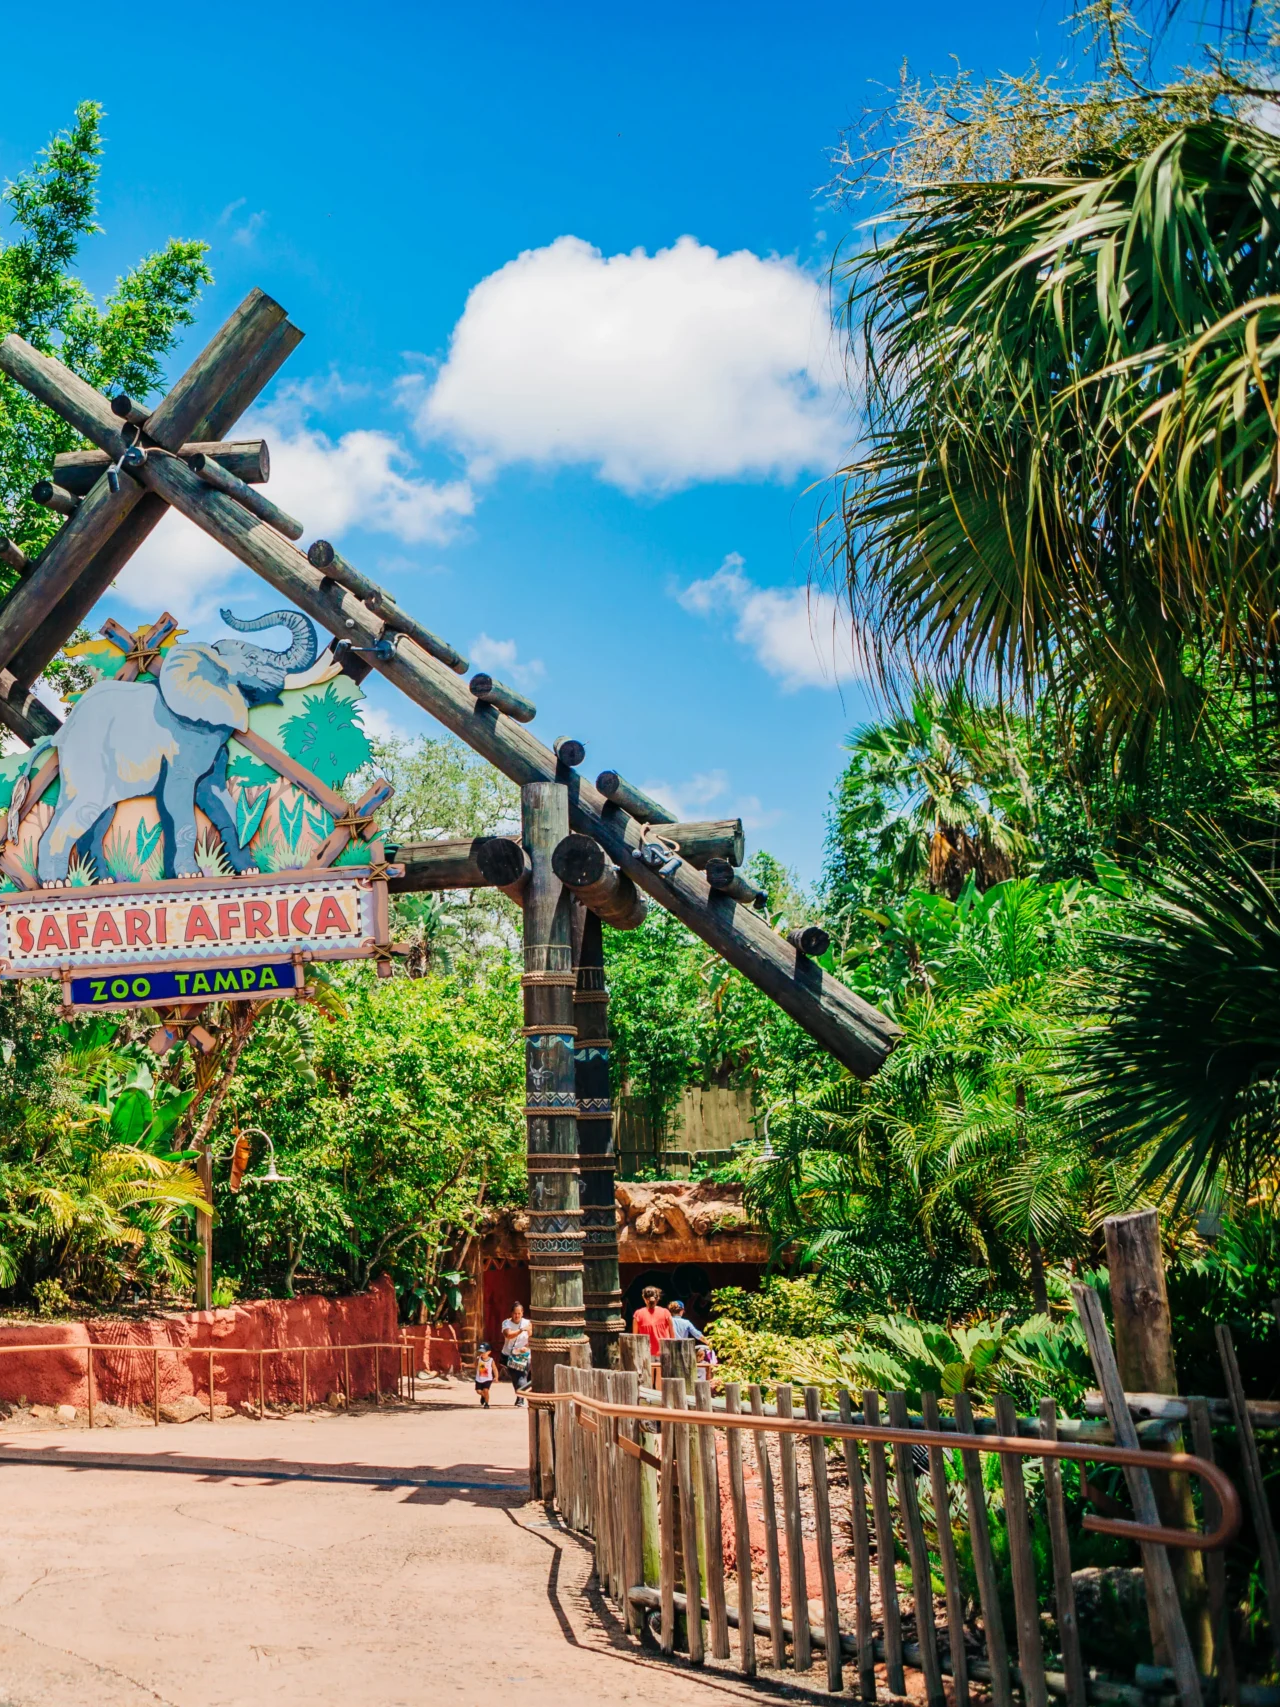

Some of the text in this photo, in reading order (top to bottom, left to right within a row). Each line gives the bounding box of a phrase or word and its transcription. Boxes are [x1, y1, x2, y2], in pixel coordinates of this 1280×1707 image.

[16, 895, 351, 953] SAFARI AFRICA
[89, 966, 279, 1002] ZOO TAMPA
